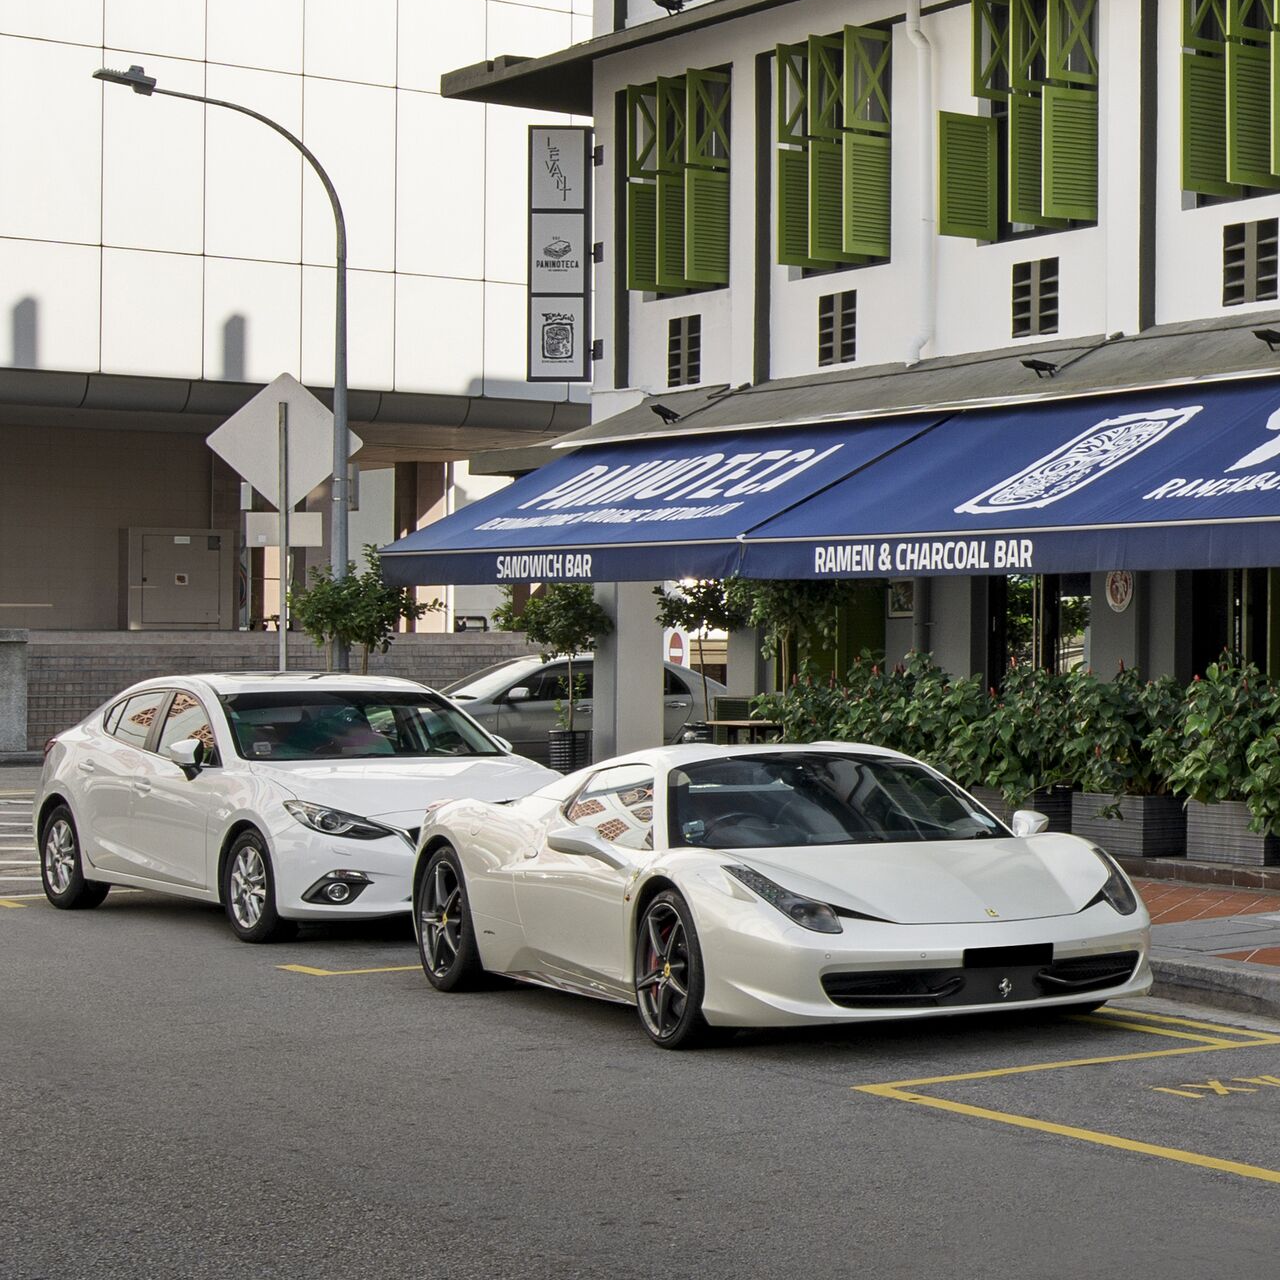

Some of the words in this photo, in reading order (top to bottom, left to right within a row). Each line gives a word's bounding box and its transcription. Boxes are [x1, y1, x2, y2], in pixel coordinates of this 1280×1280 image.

[545, 136, 572, 201] LEVANT
[536, 260, 579, 269] PANINOTECA
[516, 444, 845, 510] PANINOTECA
[496, 554, 562, 579] SANDWICH
[565, 553, 592, 578] BAR
[815, 544, 875, 573] RAMEN
[878, 542, 892, 571] &
[895, 540, 989, 570] CHARCOAL
[994, 539, 1033, 569] BAR
